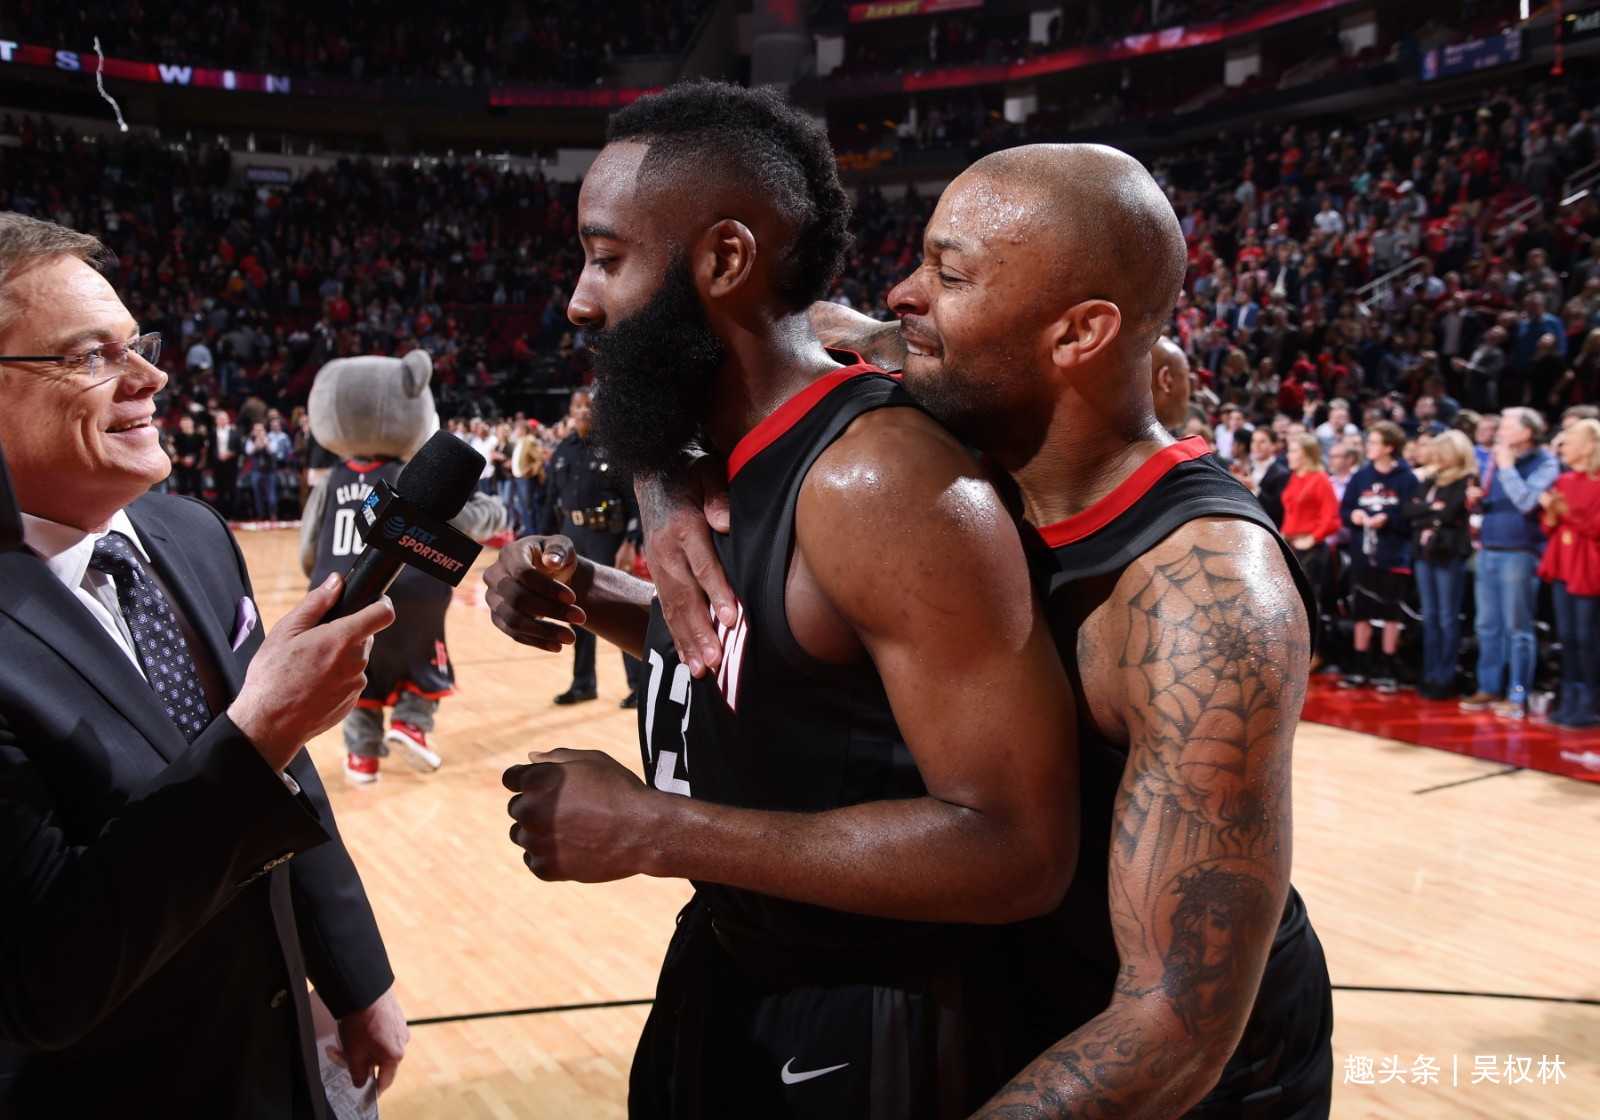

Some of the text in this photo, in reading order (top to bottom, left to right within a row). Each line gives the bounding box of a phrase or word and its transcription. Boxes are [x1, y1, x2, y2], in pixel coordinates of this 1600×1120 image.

[158, 63, 290, 93] WIN
[405, 525, 438, 545] AT&T
[398, 535, 464, 572] SPORTSNET
